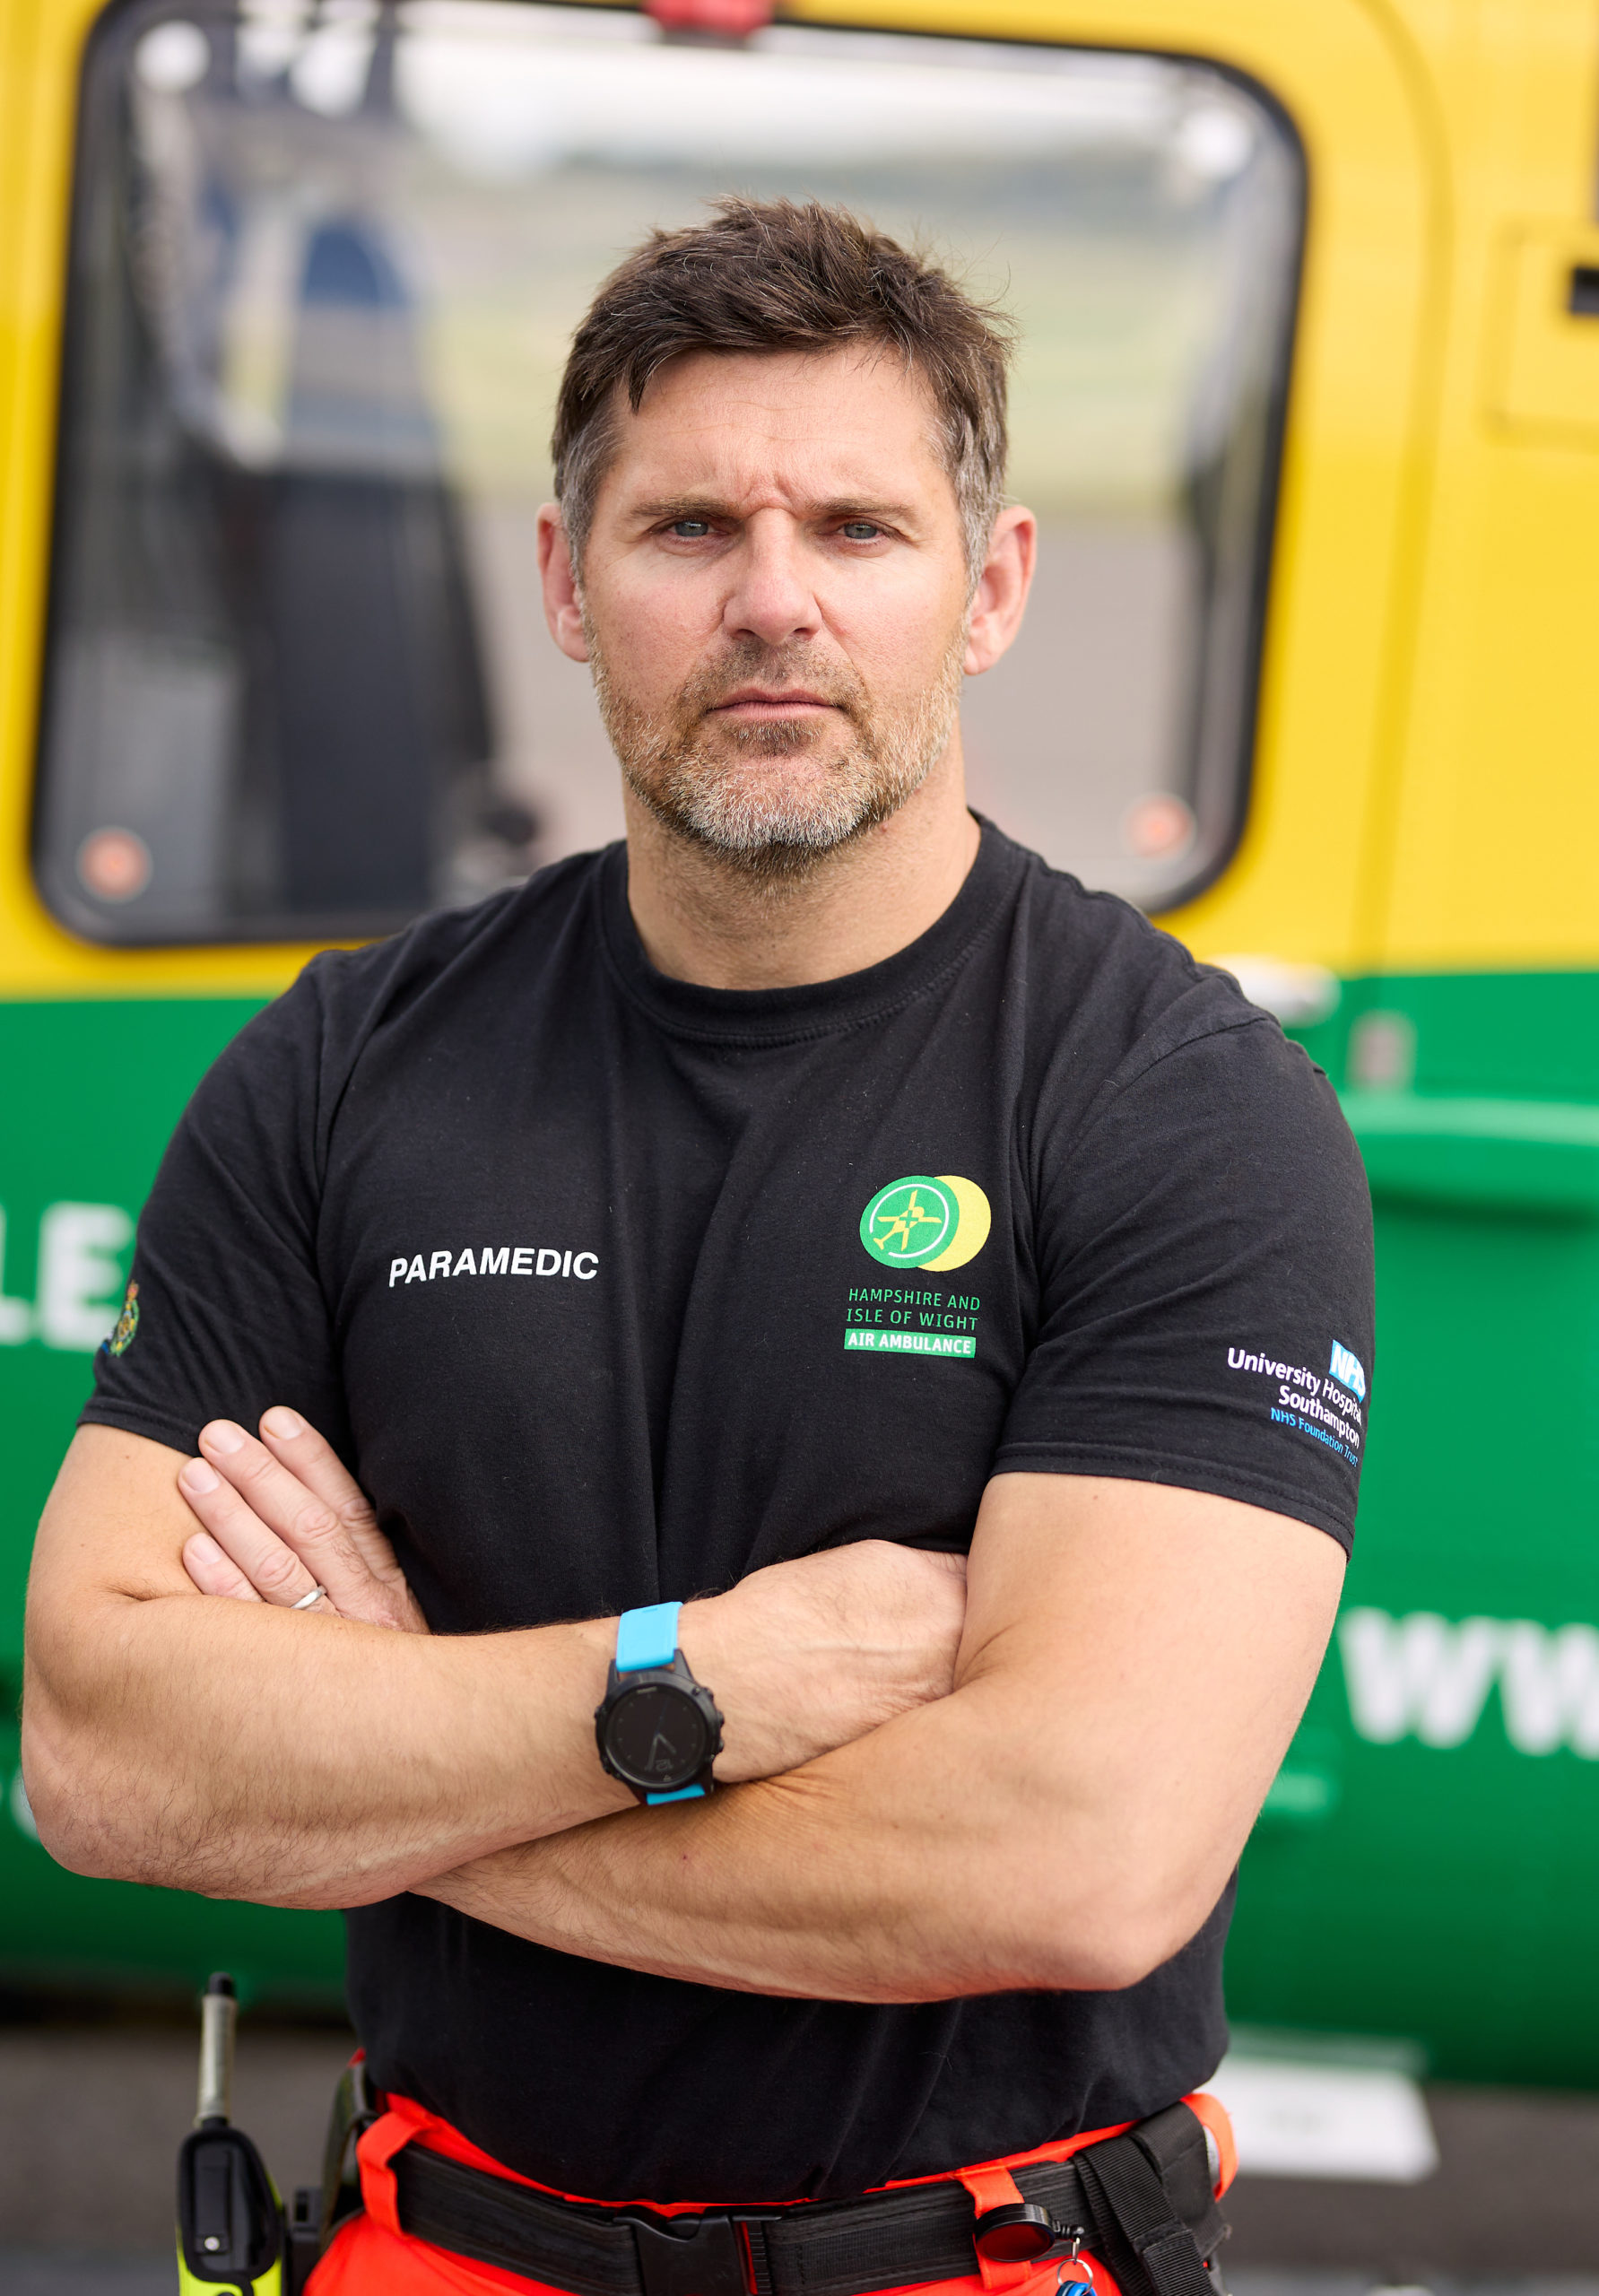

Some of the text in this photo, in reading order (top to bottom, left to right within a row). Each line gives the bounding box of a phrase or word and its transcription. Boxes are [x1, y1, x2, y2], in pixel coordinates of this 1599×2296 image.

[0, 1200, 134, 1352] E
[388, 1247, 599, 1288] PARAMEDIC
[846, 1308, 978, 1331] ISLE OF WIGHT
[848, 1288, 981, 1311] HAMPSHIRE AND
[847, 1332, 971, 1354] AIR AMBULANCE
[1227, 1347, 1320, 1397] University
[1330, 1344, 1366, 1396] NHS
[1270, 1406, 1359, 1468] NHS Foundation Trust
[1278, 1385, 1360, 1449] Southampton
